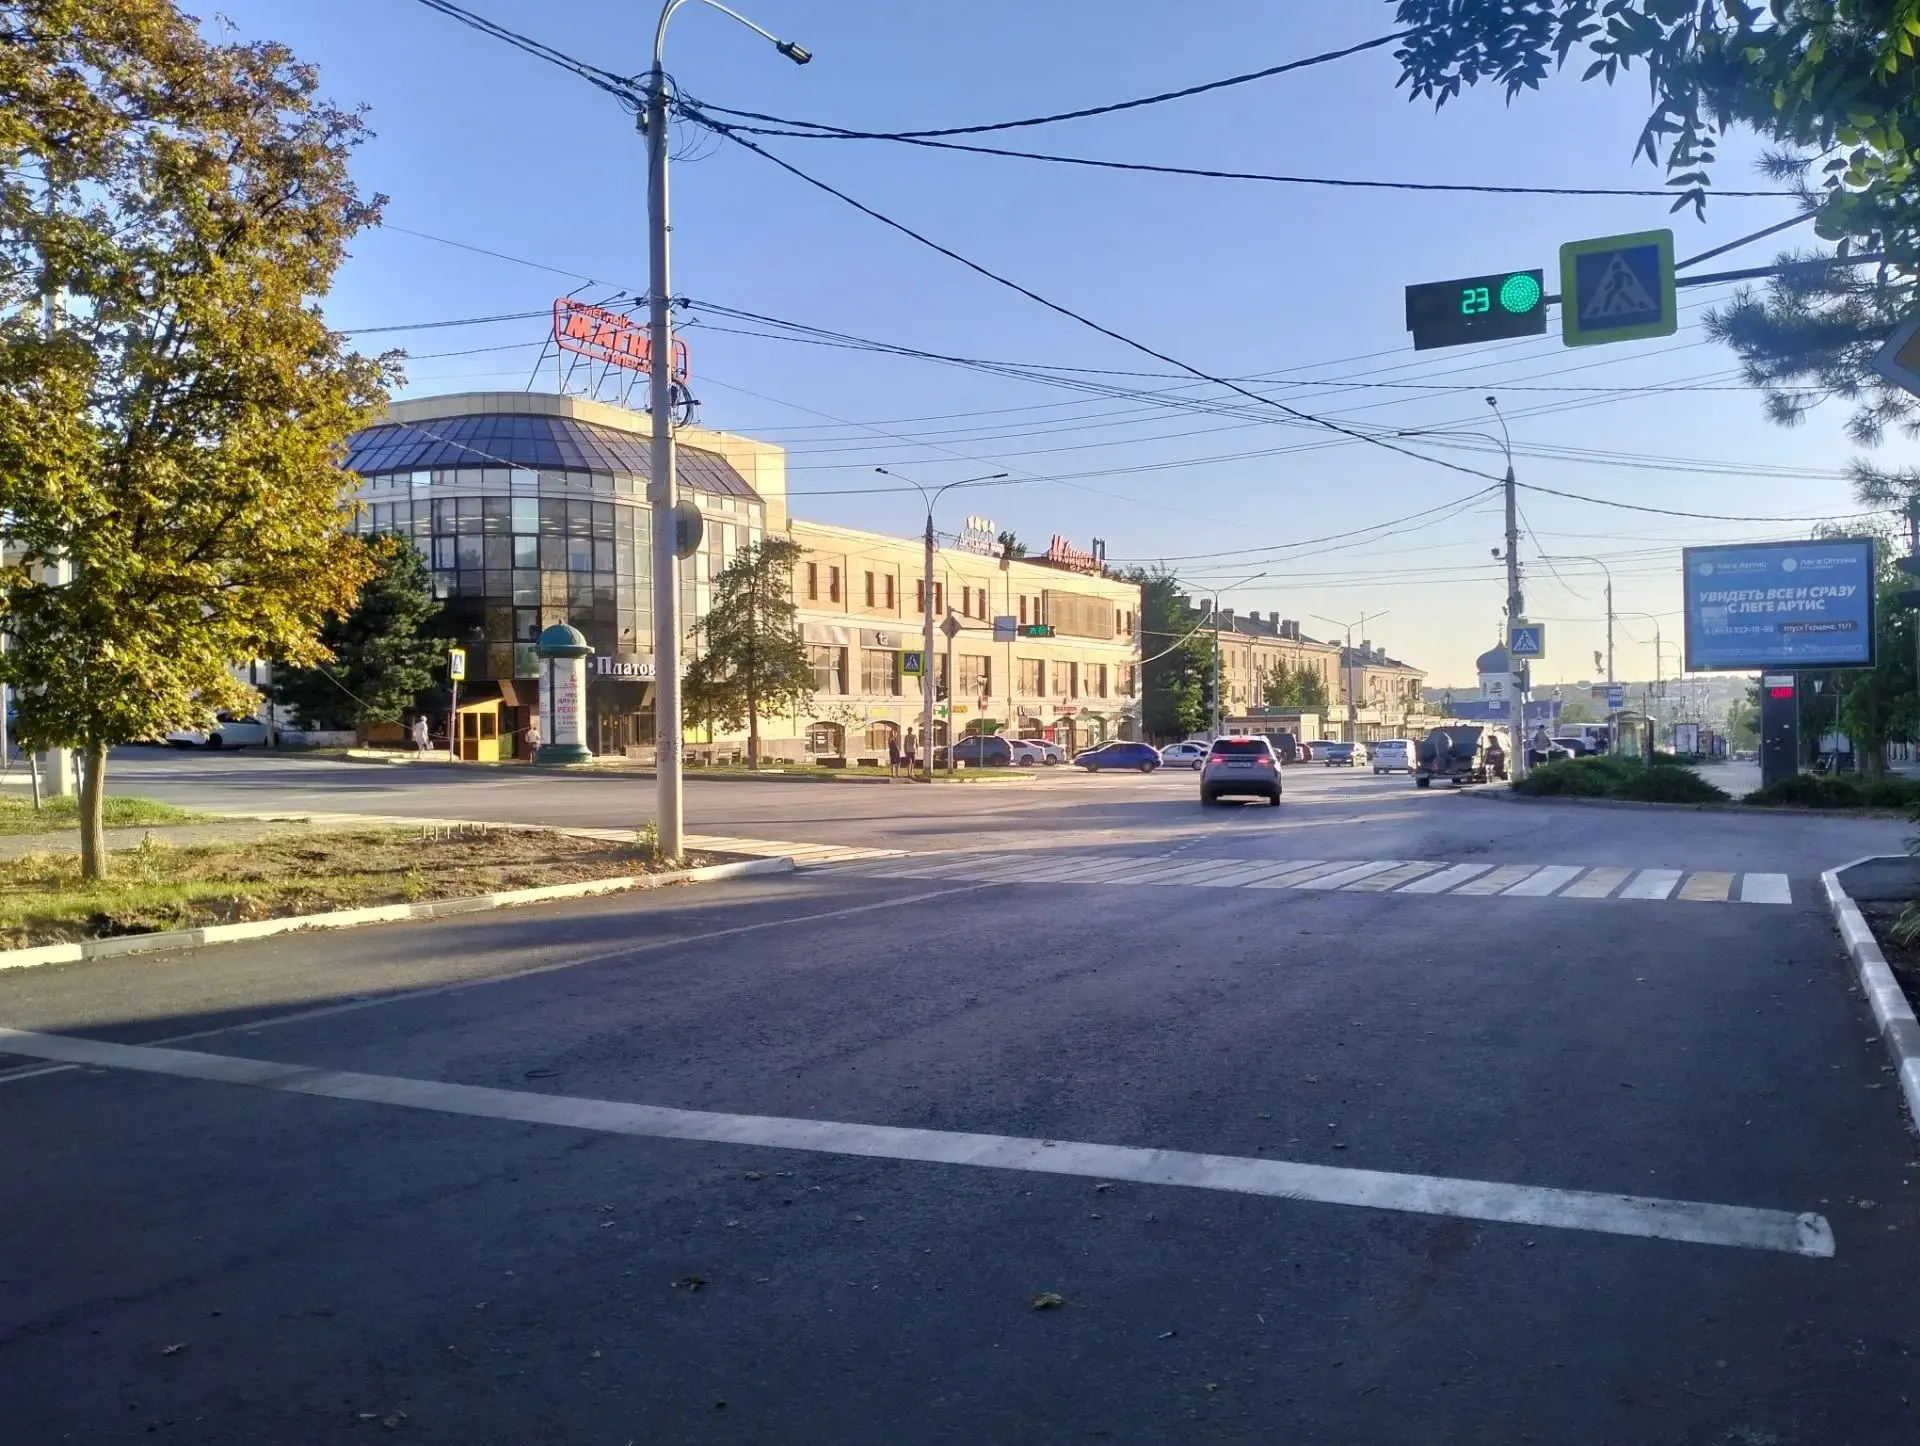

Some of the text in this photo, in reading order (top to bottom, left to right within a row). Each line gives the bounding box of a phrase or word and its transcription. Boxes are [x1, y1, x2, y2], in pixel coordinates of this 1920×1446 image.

[1462, 287, 1490, 314] 23
[565, 313, 678, 368] МАГН
[1700, 585, 1856, 603] УВИДЕТЬ ВСЕ И СРАЗУ
[1727, 600, 1826, 613] С ЛЕГЕ АРТИС
